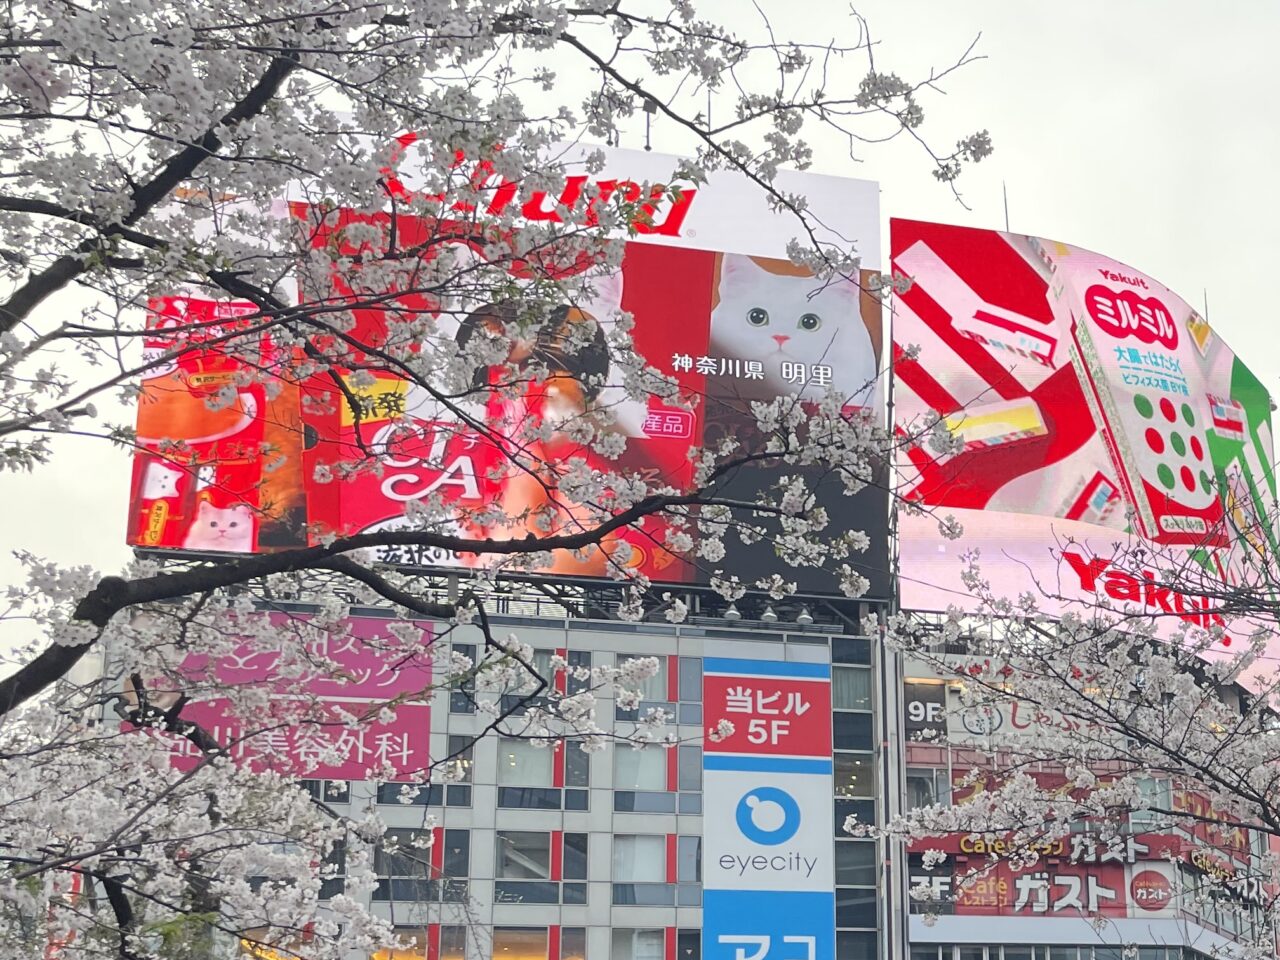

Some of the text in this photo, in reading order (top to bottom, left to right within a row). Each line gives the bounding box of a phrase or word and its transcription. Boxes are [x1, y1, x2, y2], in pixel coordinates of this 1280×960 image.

[1098, 268, 1149, 290] Yakult
[1093, 295, 1174, 340] ミルミル
[671, 353, 834, 388] 神奈川県 明里
[726, 686, 811, 716] 当ビル
[908, 701, 942, 722] 9F
[747, 719, 791, 745] 5F
[719, 852, 818, 878] eyecity
[1014, 872, 1116, 913] ガスト
[1136, 888, 1168, 900] ガスト
